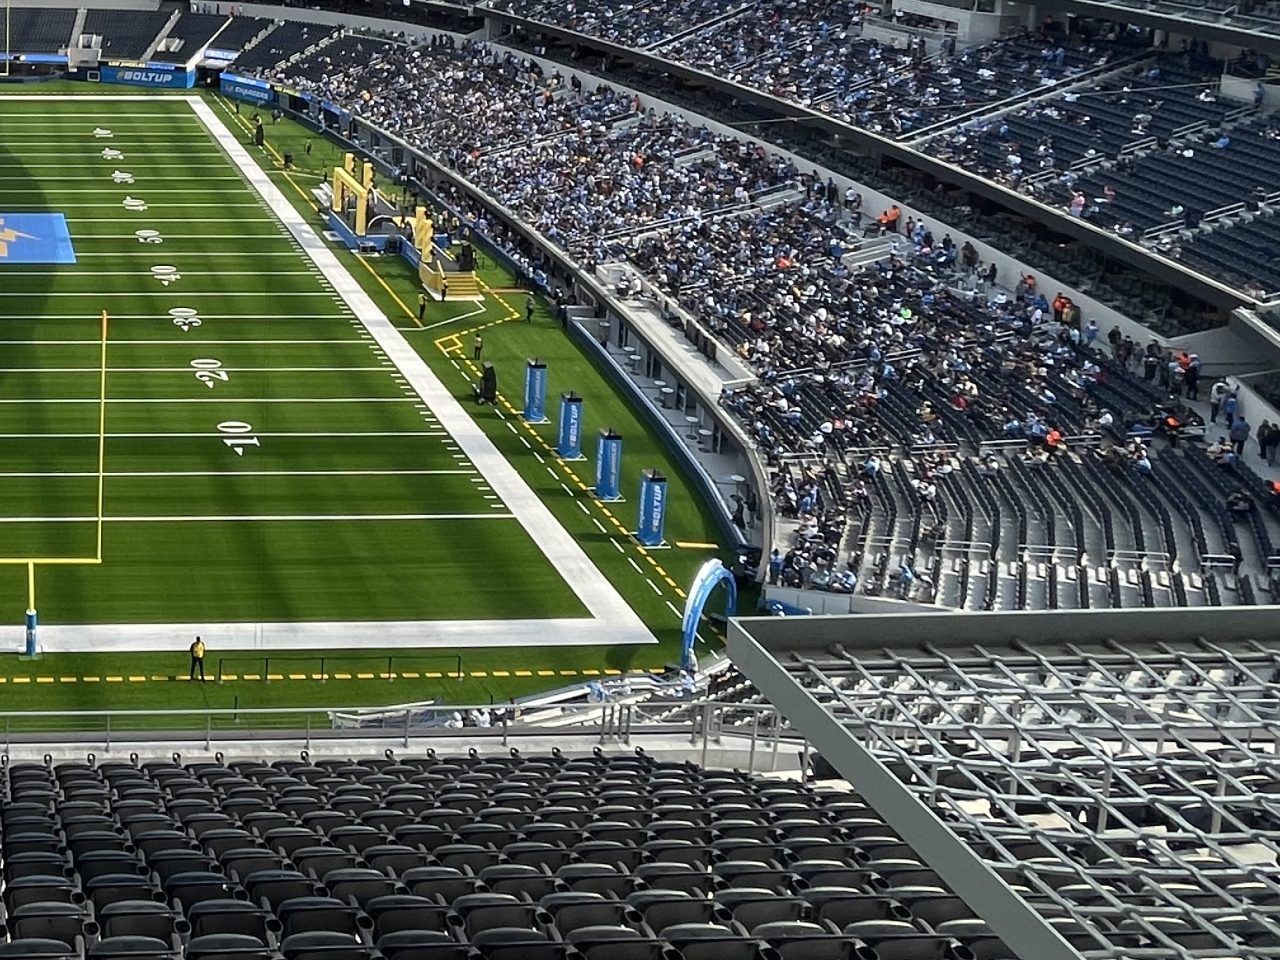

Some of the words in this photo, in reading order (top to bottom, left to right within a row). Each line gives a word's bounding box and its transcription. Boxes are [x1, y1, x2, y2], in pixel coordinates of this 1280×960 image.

[135, 230, 163, 244] 50
[168, 307, 202, 327] 30
[190, 358, 229, 381] 20
[217, 420, 261, 447] 10
